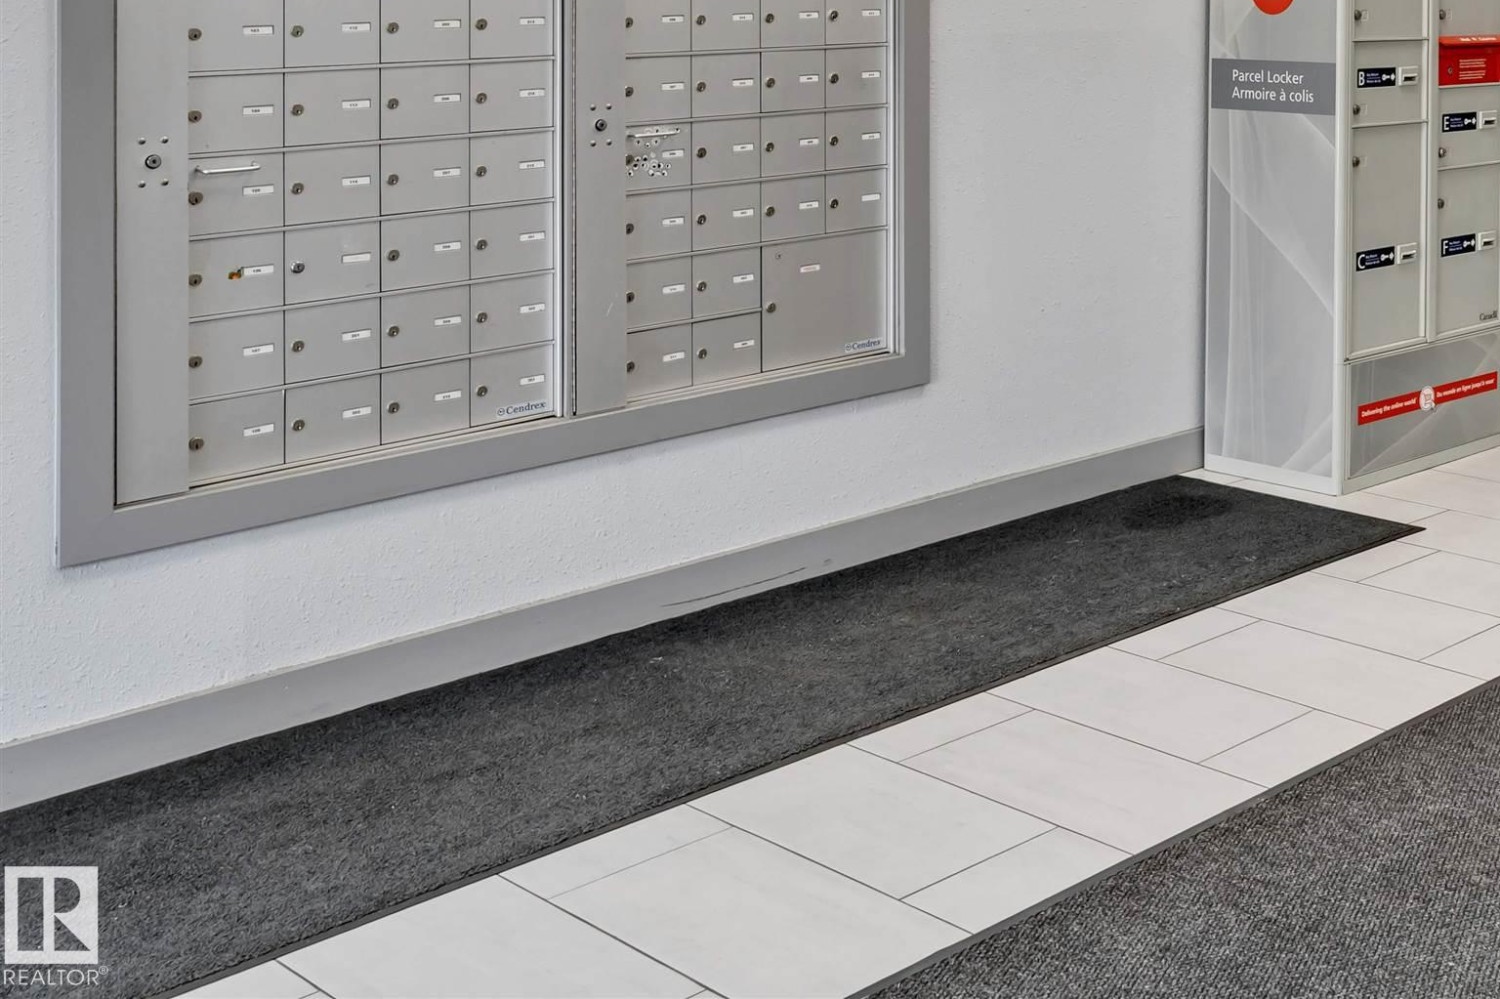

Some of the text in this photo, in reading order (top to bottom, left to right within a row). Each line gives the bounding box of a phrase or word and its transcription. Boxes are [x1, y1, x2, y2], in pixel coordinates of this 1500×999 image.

[1232, 69, 1304, 84] Parcel Locker
[1358, 72, 1365, 86] B
[1231, 86, 1314, 103] Armoire à colis
[1443, 116, 1450, 130] E
[1442, 240, 1449, 254] F
[1357, 254, 1366, 269] C
[506, 402, 546, 415] Cendrex
